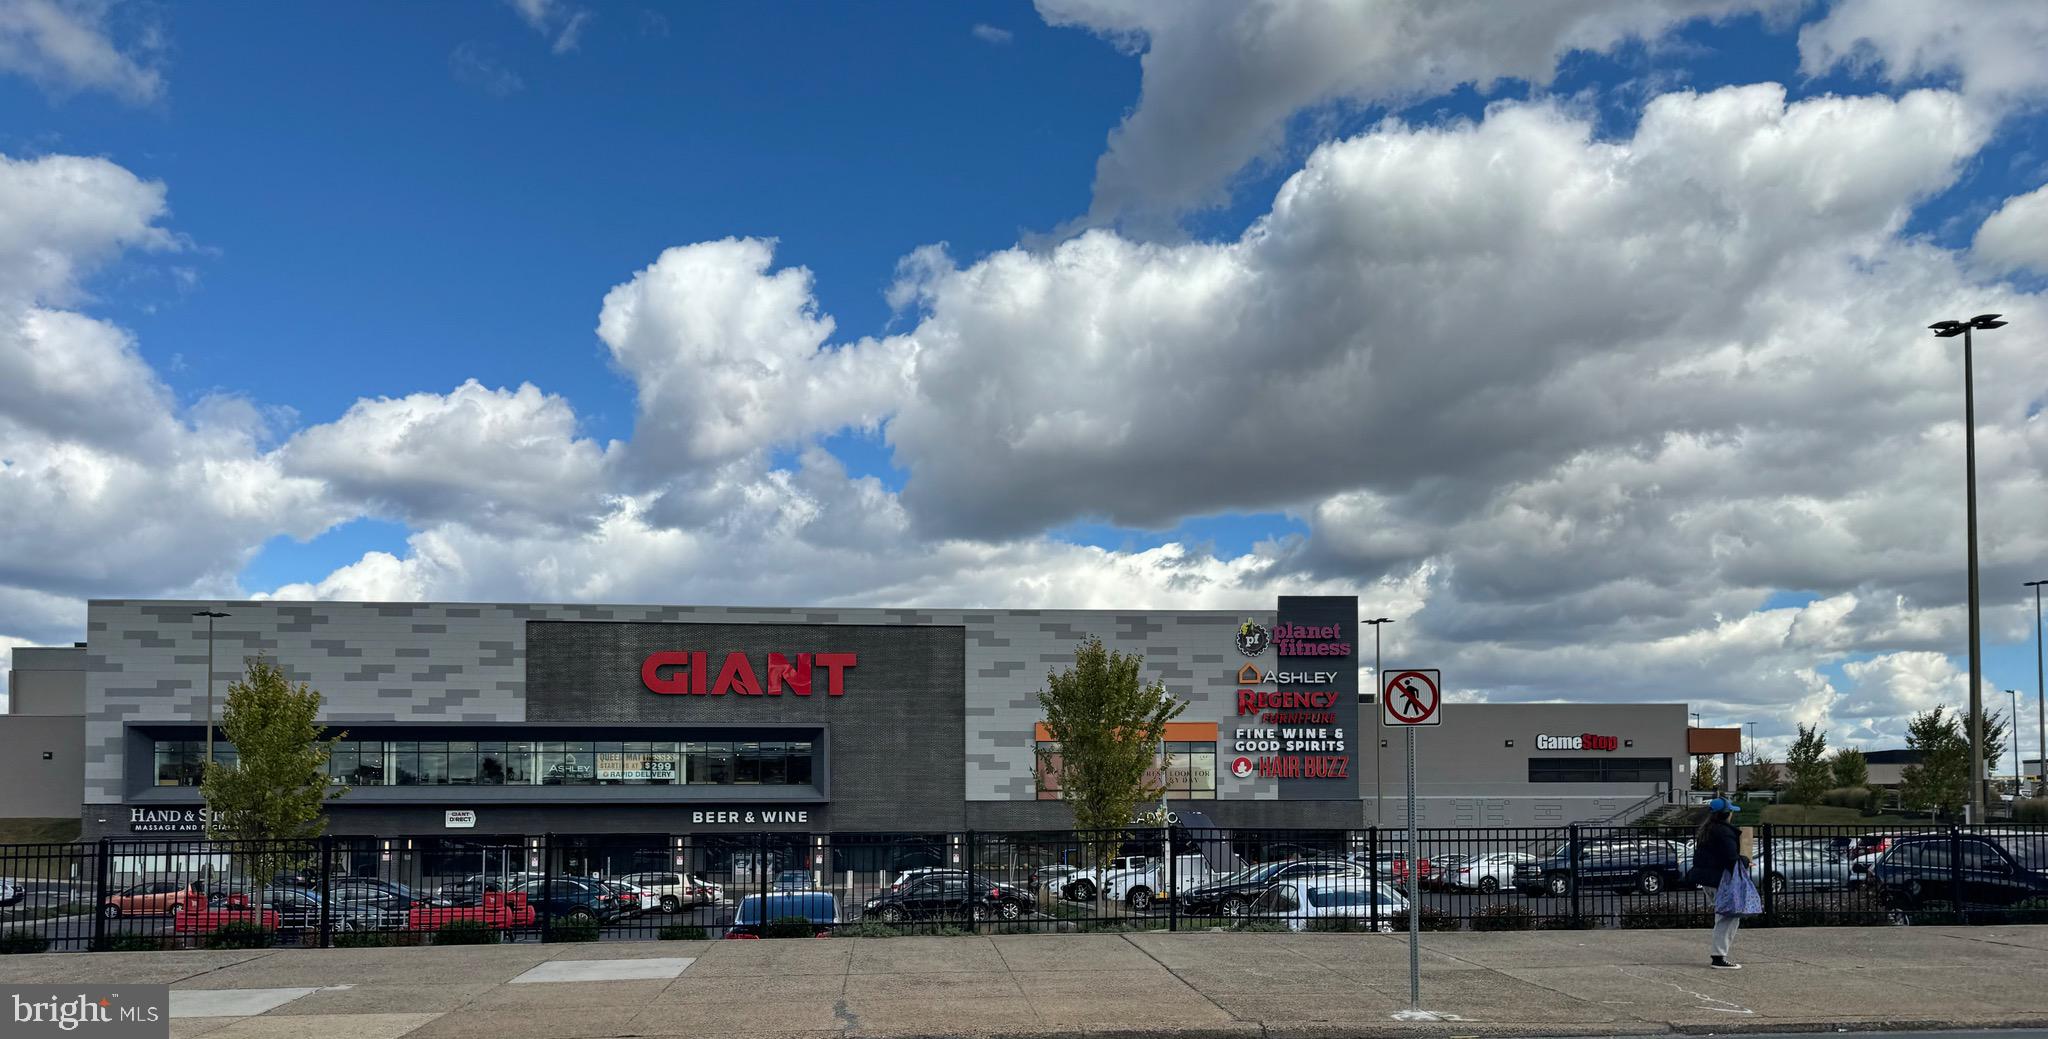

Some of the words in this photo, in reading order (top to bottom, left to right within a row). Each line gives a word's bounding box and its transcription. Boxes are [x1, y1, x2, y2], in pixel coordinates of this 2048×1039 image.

[1271, 622, 1341, 643] planet
[1245, 634, 1259, 647] pf
[1280, 639, 1351, 656] fitness
[641, 651, 857, 696] GIANT
[1263, 670, 1338, 683] ASHLEY
[1237, 689, 1339, 716] REGENCY
[1262, 712, 1337, 724] FURNITURE
[1236, 728, 1275, 739] FINE
[1282, 728, 1327, 739] WINE
[1335, 728, 1344, 739] &
[1235, 740, 1280, 752] GOOD
[1286, 740, 1345, 752] SPIRITS
[1536, 733, 1618, 751] GameStop
[549, 764, 591, 773] ASHLEY
[645, 762, 671, 770] $299
[1259, 755, 1300, 778] HAIR
[1304, 755, 1349, 778] BUZZ
[131, 808, 182, 822] HAND
[185, 810, 195, 822] &
[692, 811, 739, 823] BEER
[745, 811, 755, 823] &
[762, 811, 808, 823] WINE
